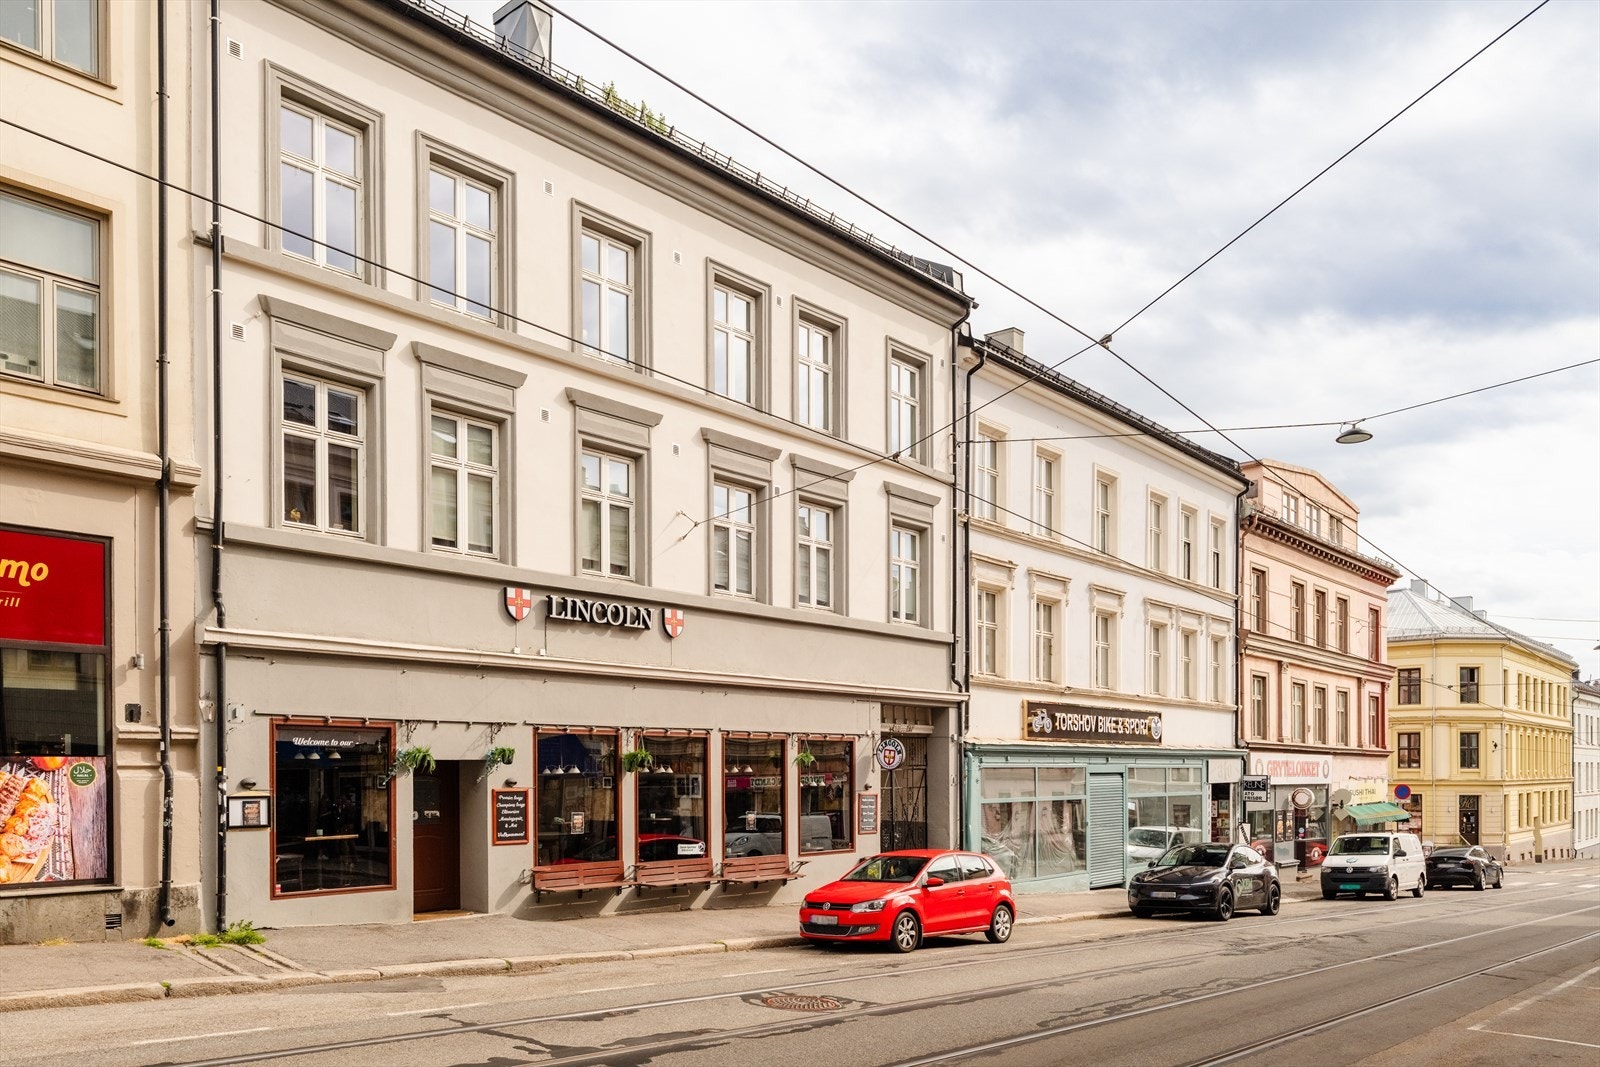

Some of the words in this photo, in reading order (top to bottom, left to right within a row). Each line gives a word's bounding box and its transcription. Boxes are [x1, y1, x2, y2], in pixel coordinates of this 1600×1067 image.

[547, 594, 655, 630] LINCOLN
[1055, 712, 1096, 732] TORSHOV
[1098, 715, 1117, 734] BIKE
[1117, 717, 1124, 734] &
[1124, 718, 1149, 735] SPORT
[292, 737, 330, 746] Welcome
[878, 739, 902, 755] LINCOLN
[1266, 760, 1320, 777] GRYTELOKKET
[1243, 780, 1265, 789] KEUNE
